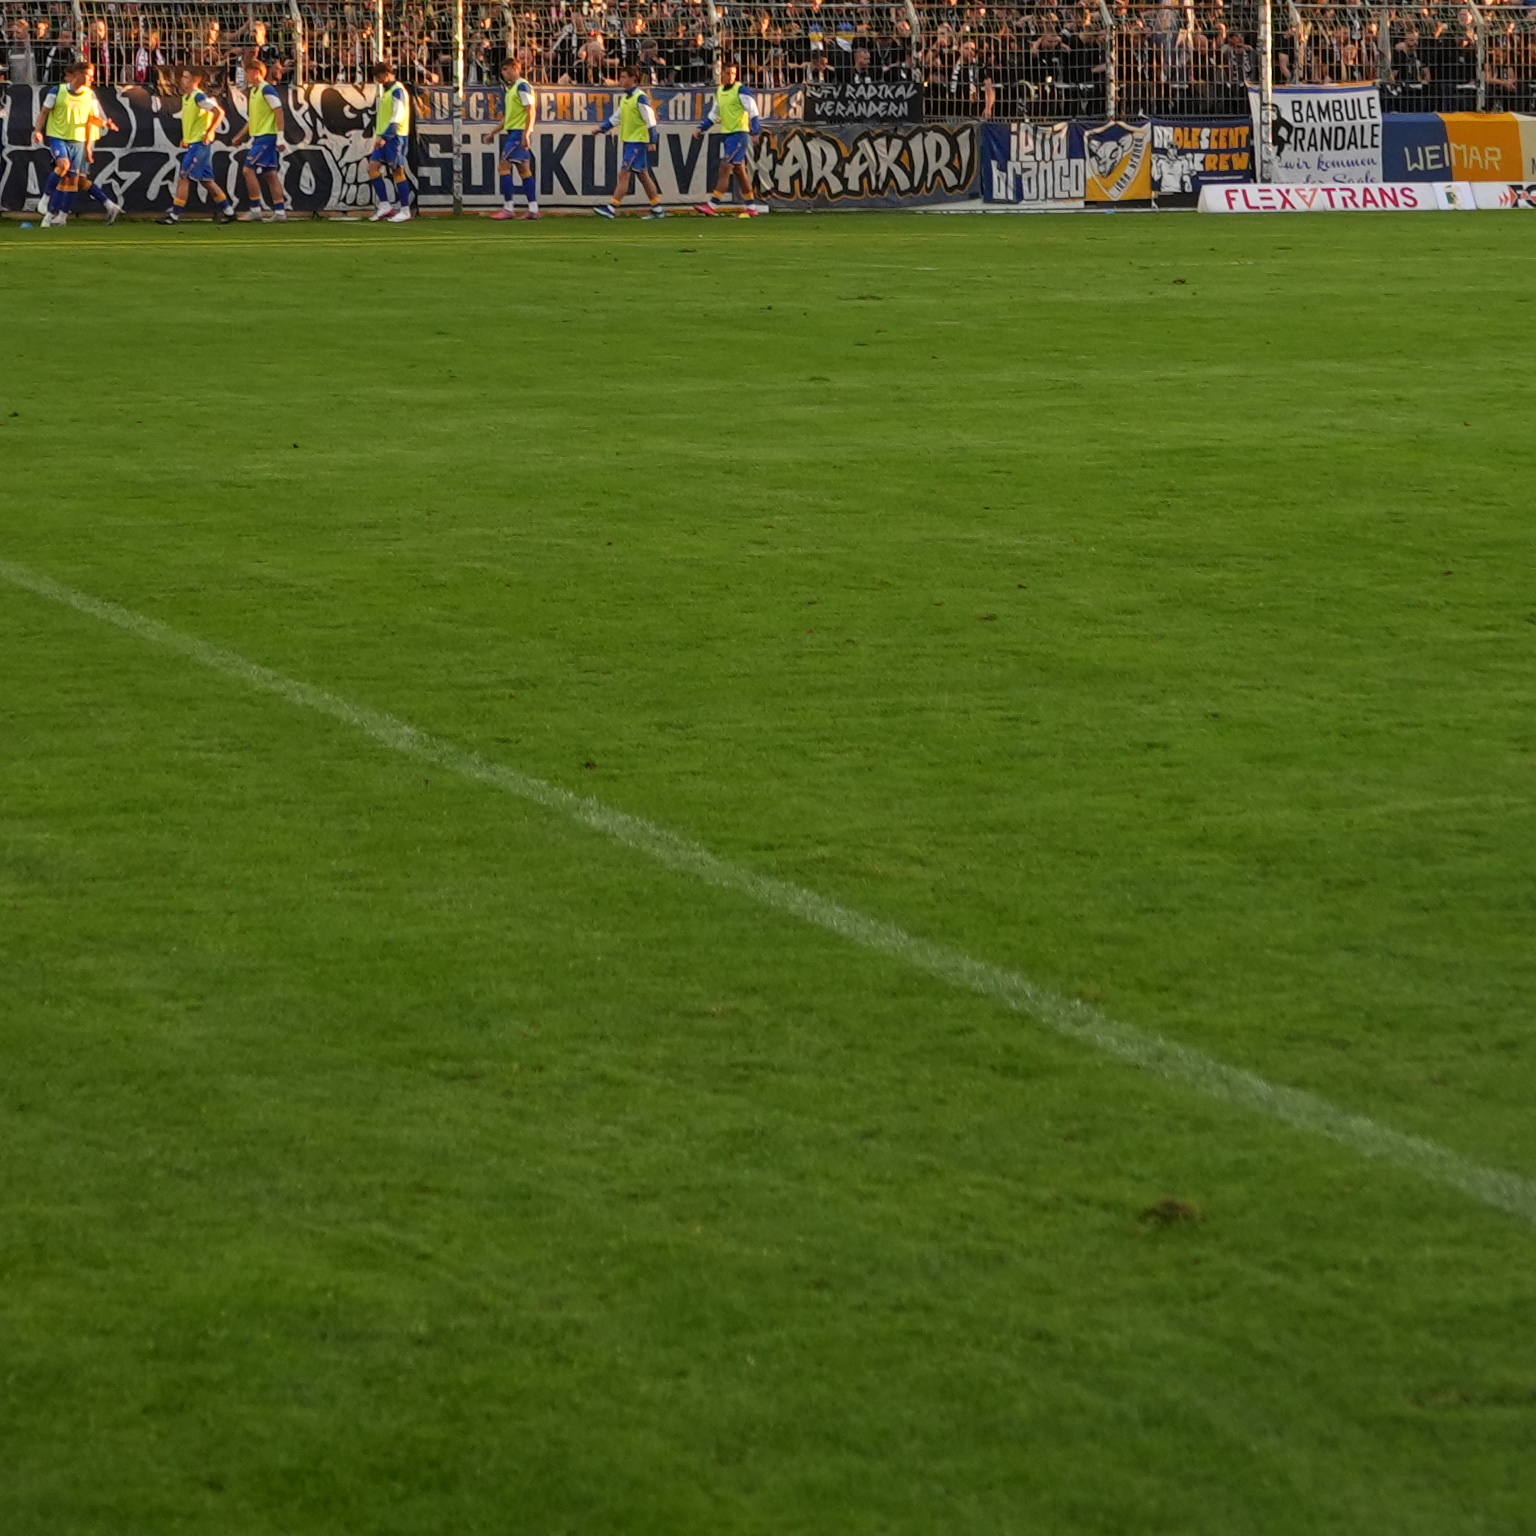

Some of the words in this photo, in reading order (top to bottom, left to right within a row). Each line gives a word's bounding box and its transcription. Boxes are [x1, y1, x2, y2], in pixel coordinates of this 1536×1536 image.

[845, 82, 919, 100] RADIKAL
[814, 100, 909, 119] VERÄNDERN
[1291, 96, 1378, 124] BAMBULE
[1293, 123, 1380, 153] RANDALE
[747, 127, 972, 195] HARAKIRI
[1404, 143, 1502, 172] WEIMAR
[990, 158, 1085, 201] branco
